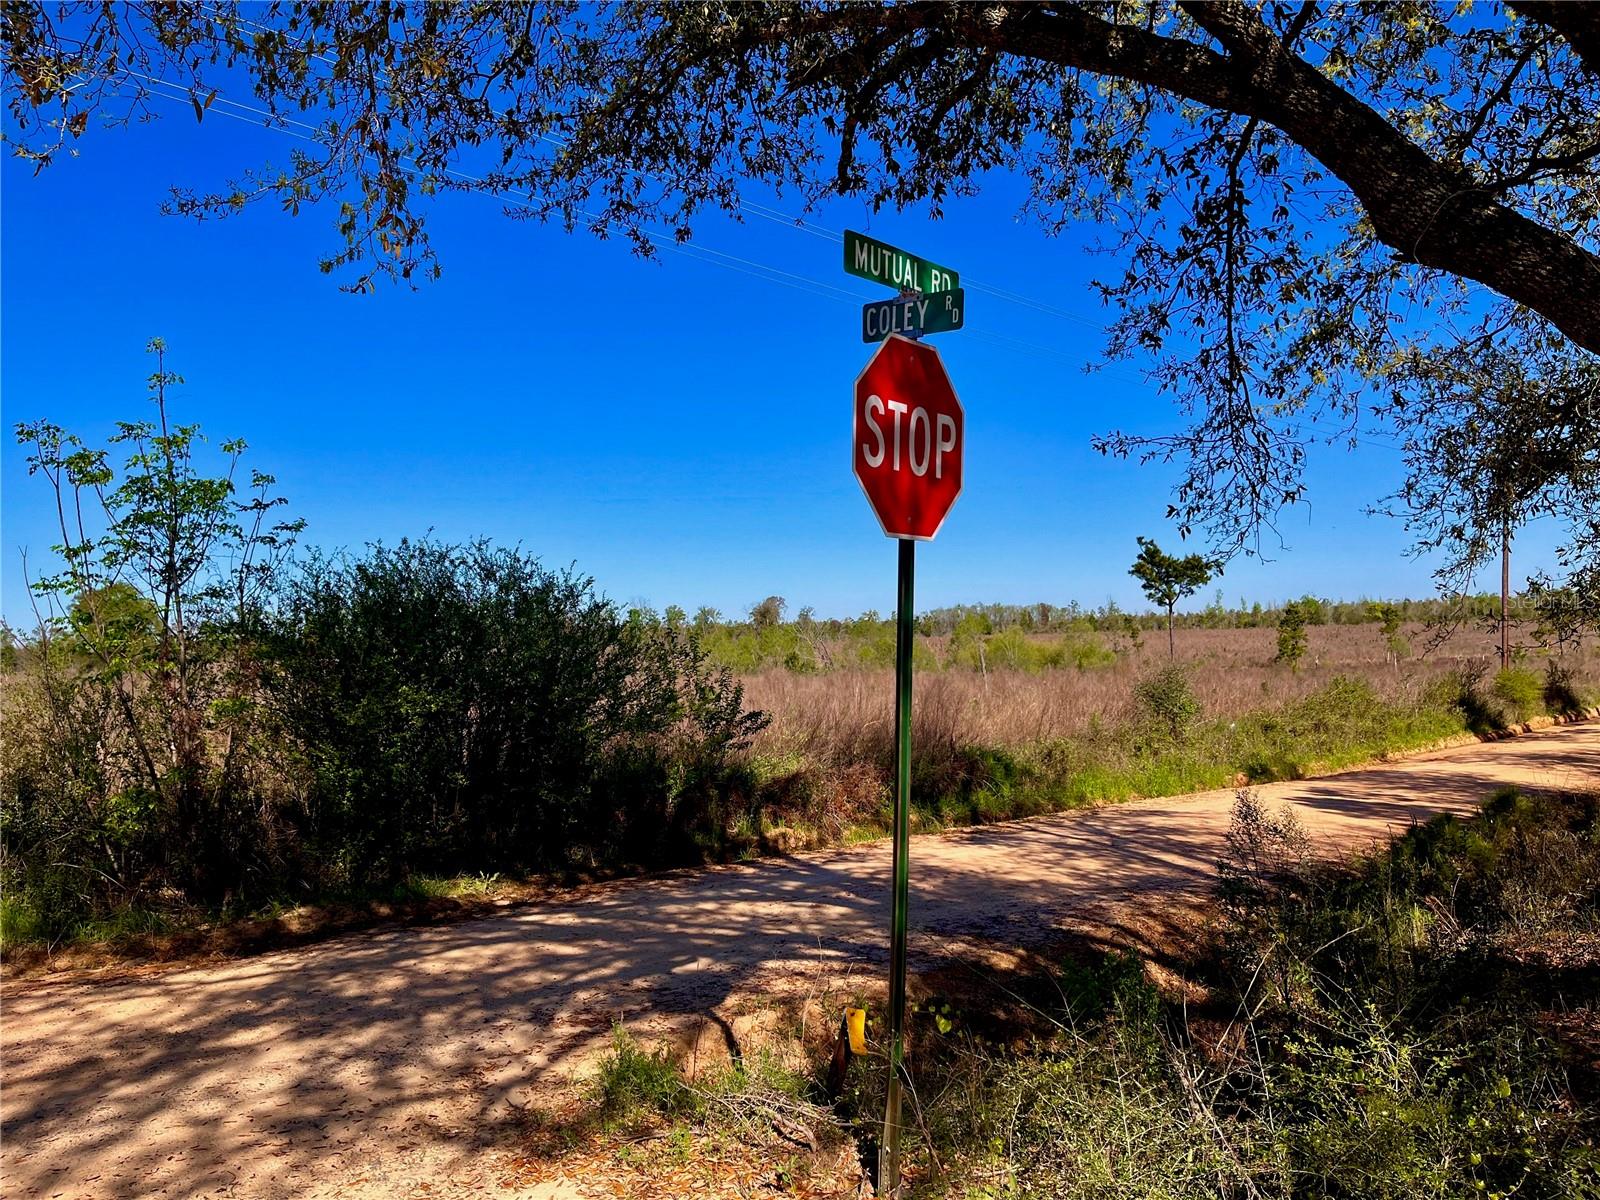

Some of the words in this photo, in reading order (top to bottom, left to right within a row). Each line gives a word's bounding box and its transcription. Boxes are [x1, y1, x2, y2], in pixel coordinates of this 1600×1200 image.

[855, 239, 922, 292] MUTUAL
[931, 269, 950, 293] RD
[866, 300, 929, 336] COLEY
[945, 295, 959, 323] RD
[862, 394, 956, 479] STOP
